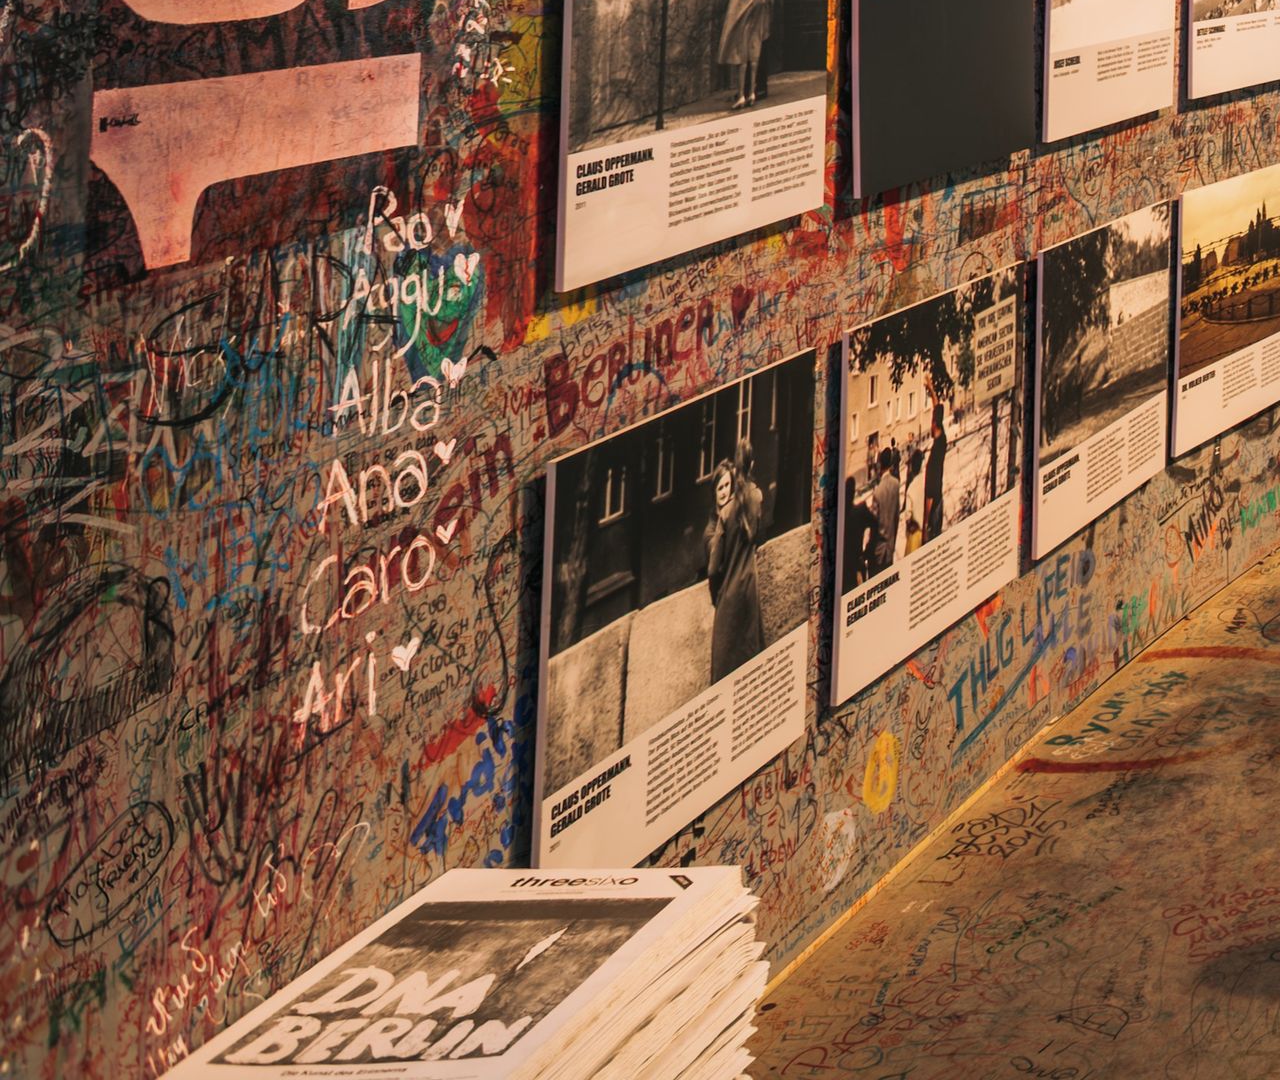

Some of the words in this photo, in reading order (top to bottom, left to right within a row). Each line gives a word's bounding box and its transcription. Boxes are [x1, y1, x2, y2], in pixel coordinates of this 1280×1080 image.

[576, 158, 604, 179] CLAUS
[576, 175, 607, 196] GERALD
[608, 169, 634, 189] GROTE
[328, 358, 443, 438] Alba
[317, 449, 428, 534] Ana
[301, 534, 437, 635] Caro
[293, 630, 379, 745] Ari
[550, 803, 583, 839] GERALD
[584, 784, 611, 816] GROTE
[551, 790, 579, 821] CLAUS
[293, 966, 496, 1018] DNA
[224, 1016, 532, 1064] BERLIN
